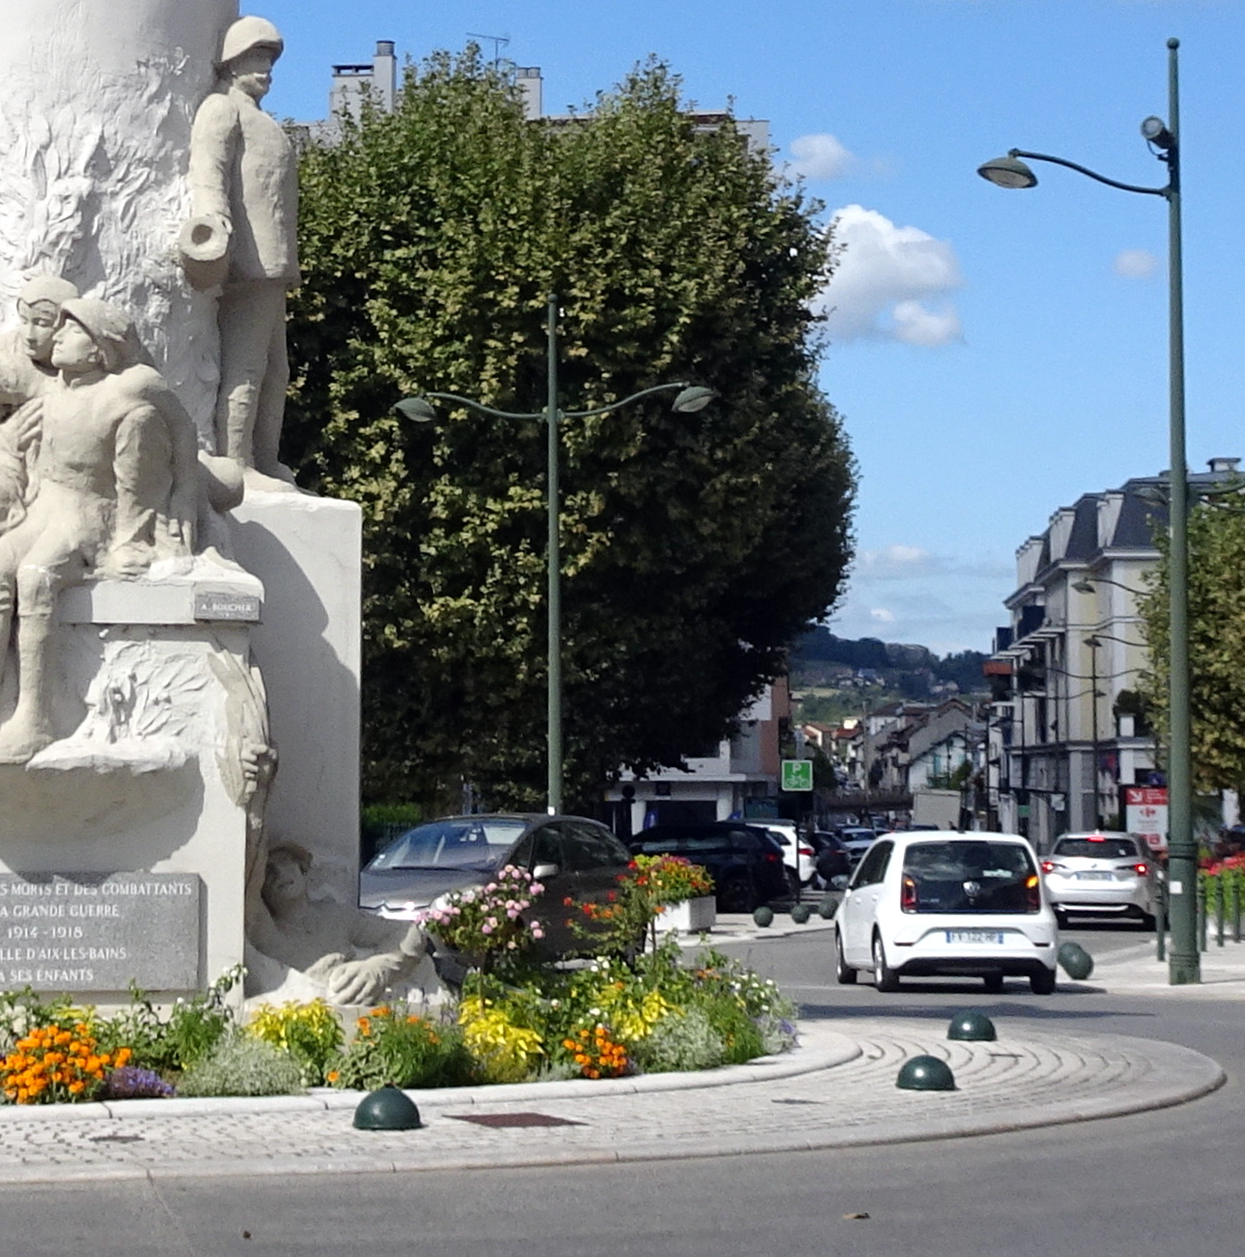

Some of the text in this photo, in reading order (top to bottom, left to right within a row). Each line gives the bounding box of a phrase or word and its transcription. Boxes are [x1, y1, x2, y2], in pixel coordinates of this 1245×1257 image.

[792, 763, 802, 774] P
[11, 883, 52, 896] MORTS
[55, 883, 69, 896] ET
[75, 883, 98, 896] DES
[101, 883, 192, 896] COMBATTANTS
[13, 904, 65, 917] GRANDE
[69, 904, 119, 917] GUERRE
[8, 927, 38, 939] 1914
[52, 926, 83, 939] 1918
[10, 969, 32, 982] SES
[37, 968, 93, 982] ENFANTS
